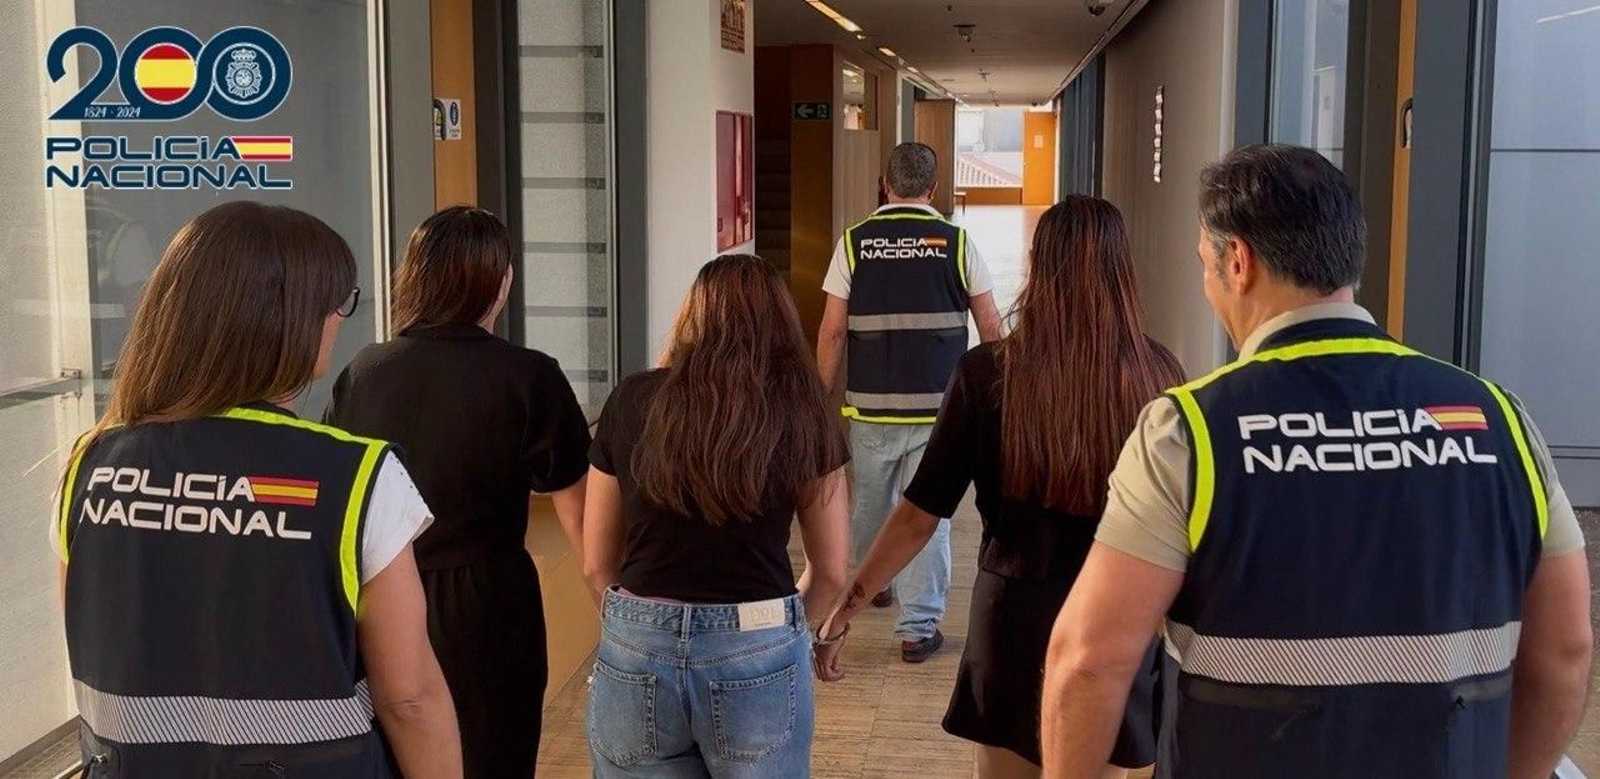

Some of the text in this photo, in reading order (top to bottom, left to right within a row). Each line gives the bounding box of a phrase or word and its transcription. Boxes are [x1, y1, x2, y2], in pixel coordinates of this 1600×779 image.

[861, 248, 946, 260] NACIONAL
[1243, 436, 1497, 474] NACIONAL
[79, 498, 312, 540] NACIONAL
